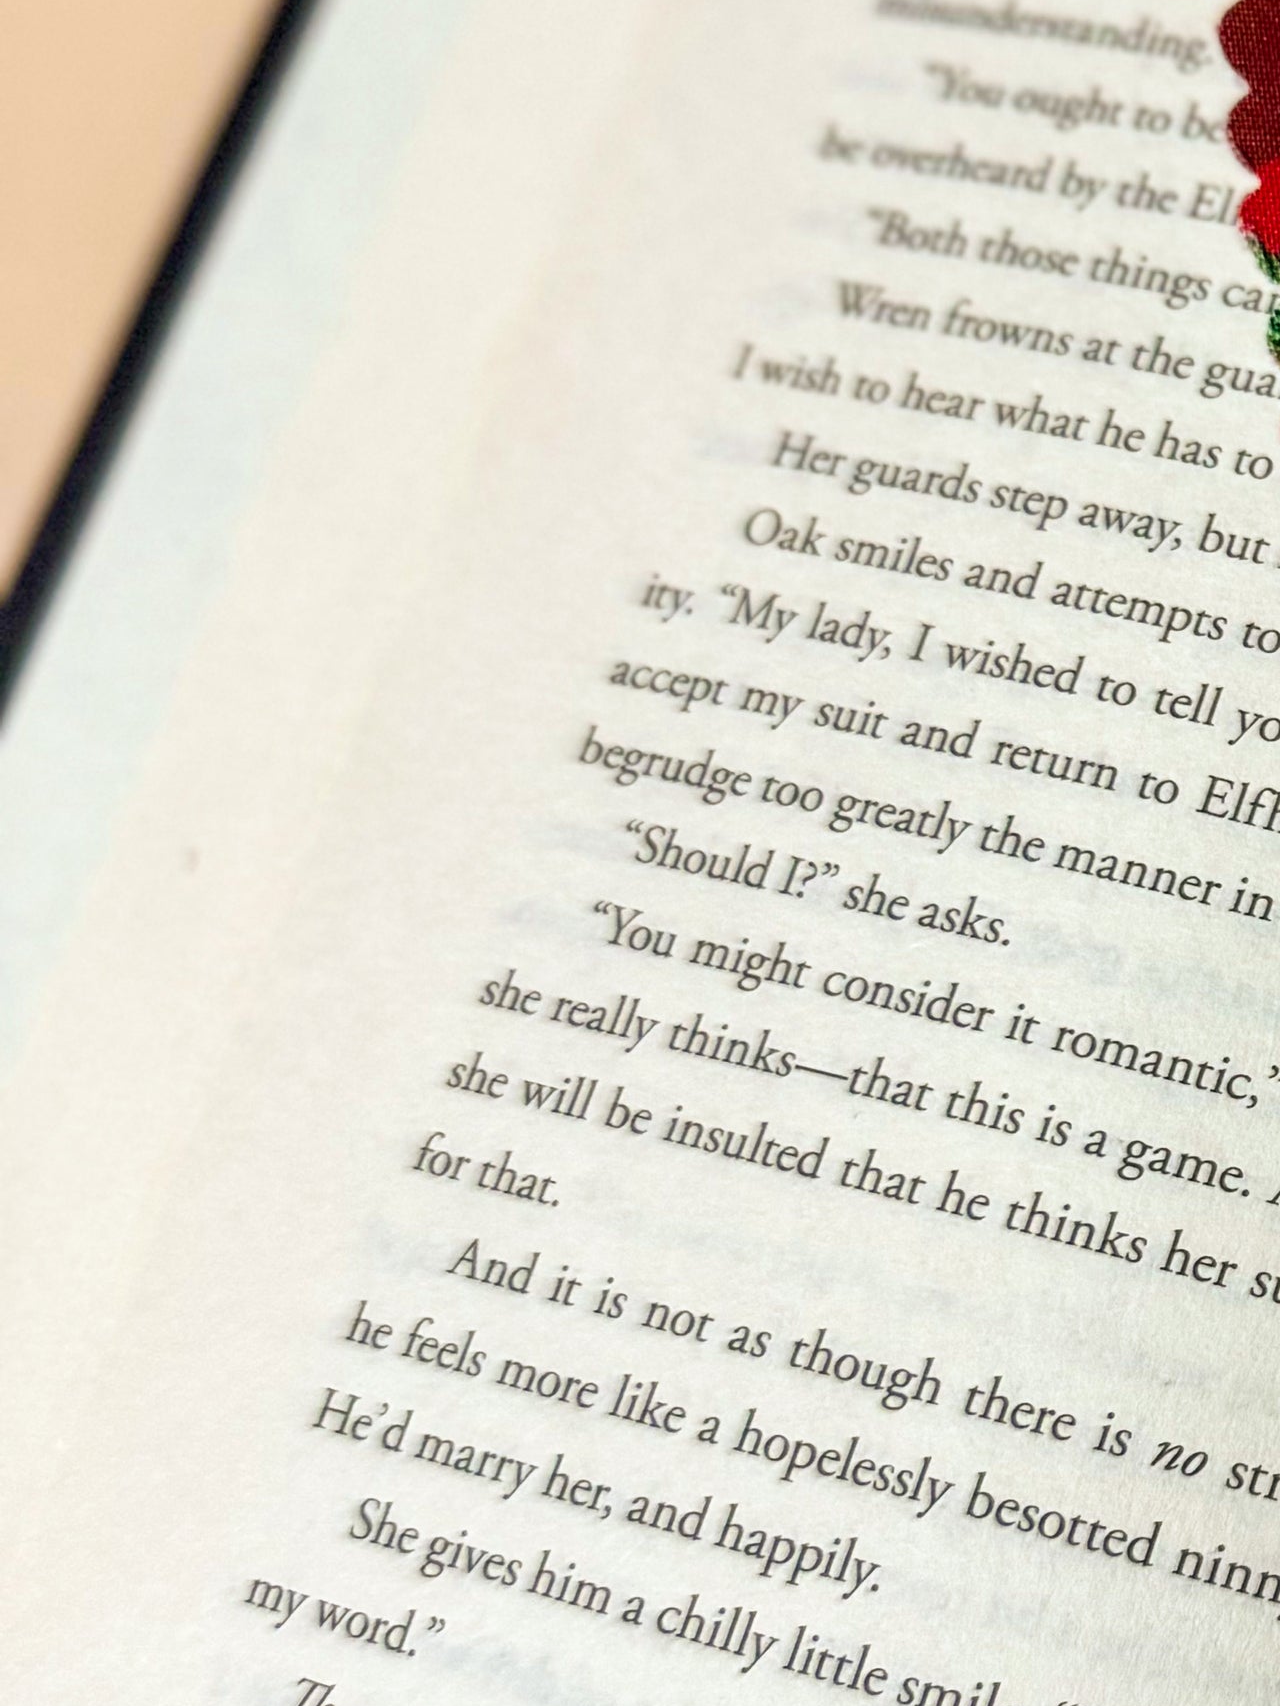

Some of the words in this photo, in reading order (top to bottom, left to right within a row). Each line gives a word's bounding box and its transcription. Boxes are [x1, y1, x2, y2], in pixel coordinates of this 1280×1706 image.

[742, 508, 826, 557] Oak
[833, 535, 955, 583] smiles
[961, 559, 1045, 601] and
[1048, 581, 1229, 645] attempts
[641, 584, 693, 615] ity.
[720, 585, 799, 644] “My
[805, 601, 892, 663] lady,
[908, 622, 935, 662] I
[945, 640, 1086, 695] wished
[1095, 675, 1137, 707] to
[1153, 683, 1224, 727] tell
[578, 725, 752, 806] begrudge
[760, 776, 824, 812] too
[827, 794, 974, 855] greatly
[978, 814, 1046, 863] the
[1052, 844, 1223, 906] manner
[1227, 876, 1274, 922] in
[625, 820, 776, 890] “Should
[777, 855, 840, 899] I?”
[841, 873, 910, 921] she
[916, 895, 1010, 947] asks.
[477, 968, 542, 1016] she
[549, 994, 661, 1054] really
[667, 1013, 935, 1112] thinks—that
[944, 1080, 1026, 1135] this
[1034, 1104, 1073, 1147] is
[1082, 1130, 1108, 1158] a
[1116, 1139, 1250, 1198] game.
[411, 1131, 472, 1181] for
[476, 1150, 559, 1208] that.
[311, 1387, 414, 1453] He’d
[413, 1433, 539, 1501] marry
[540, 1453, 612, 1520] her,
[625, 1495, 713, 1542] and
[712, 1503, 881, 1600] happily.
[344, 1300, 393, 1350] he
[400, 1317, 487, 1377] feels
[495, 1359, 599, 1409] more
[607, 1373, 687, 1434] like
[696, 1416, 721, 1445] a
[731, 1407, 956, 1519] hopelessly
[964, 1471, 1163, 1568] besotted
[243, 1579, 310, 1630] my
[317, 1599, 446, 1657] word.”
